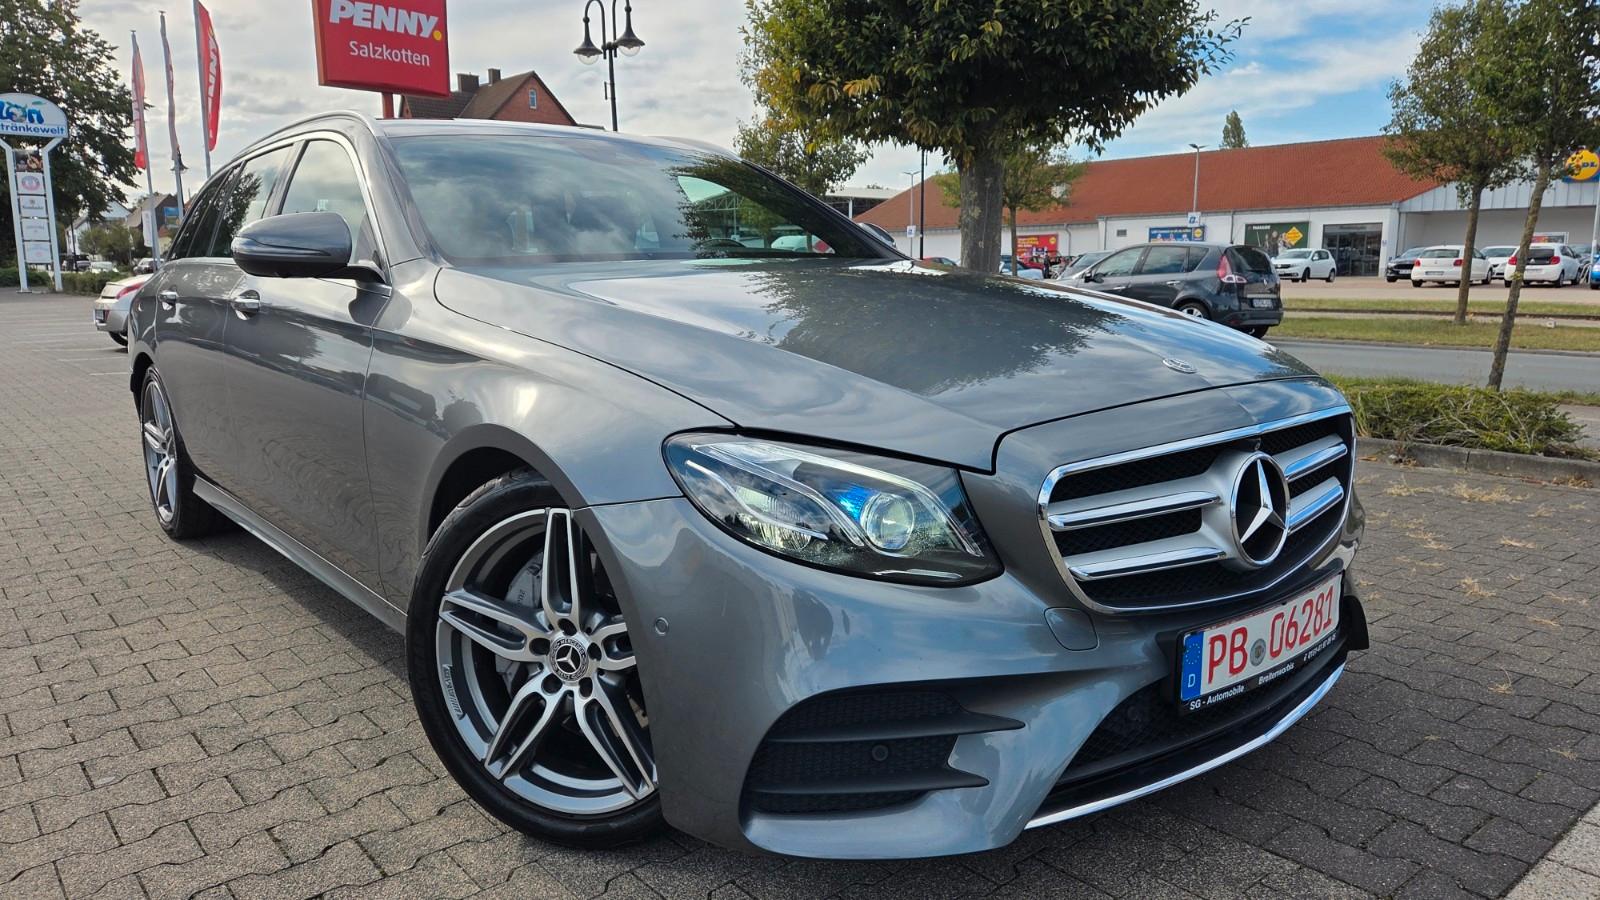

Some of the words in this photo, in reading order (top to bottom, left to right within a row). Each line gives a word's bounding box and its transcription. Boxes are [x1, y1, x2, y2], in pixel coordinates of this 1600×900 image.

[349, 40, 430, 66] Salzkotten
[1208, 627, 1248, 684] PB
[1269, 585, 1333, 659] 06281
[1188, 673, 1196, 688] D
[1189, 699, 1201, 711] SG
[1207, 685, 1245, 705] Automobile
